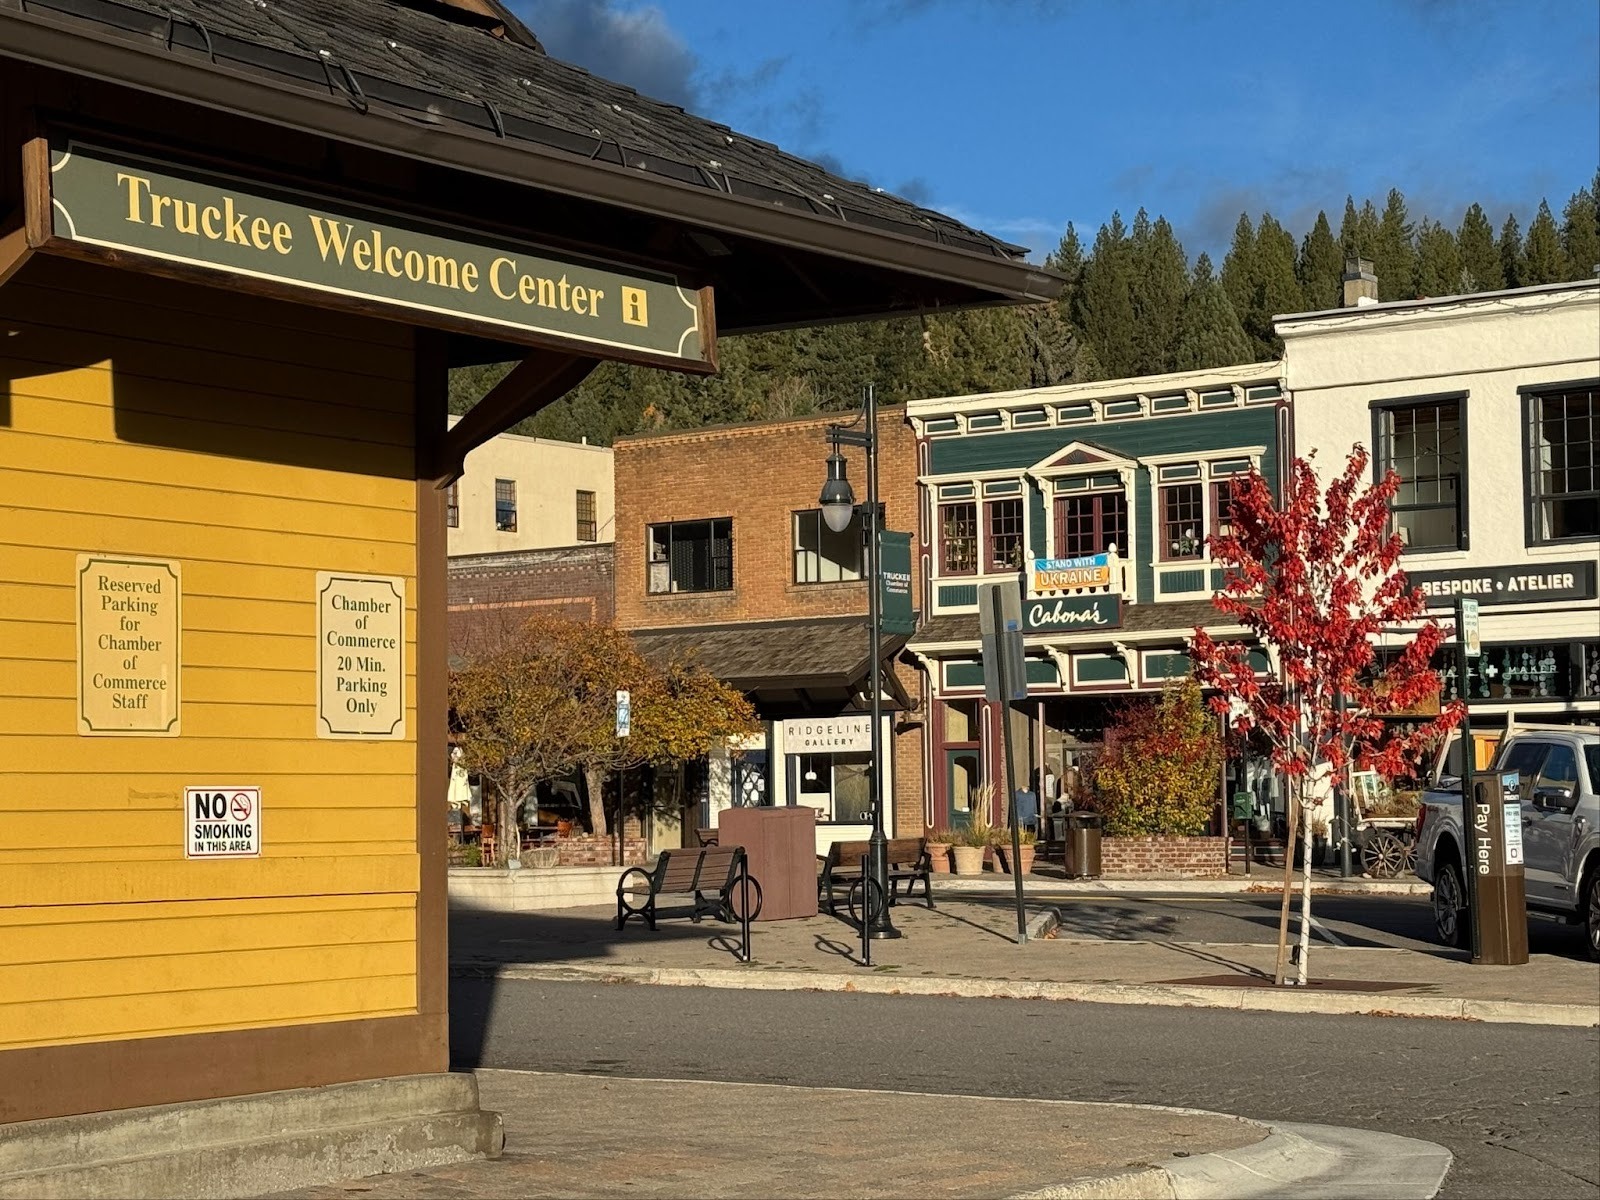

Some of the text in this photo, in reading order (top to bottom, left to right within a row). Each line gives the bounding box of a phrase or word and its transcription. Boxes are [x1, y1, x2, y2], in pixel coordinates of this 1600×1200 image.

[117, 172, 292, 256] Truckee
[308, 213, 479, 293] Welcome
[488, 257, 604, 318] Center
[1045, 557, 1096, 569] STAND WITH
[98, 575, 161, 594] Reserved
[1041, 568, 1102, 586] UKRAINE
[1422, 573, 1574, 597] BESPOKE ATELIER
[101, 595, 158, 616] Parking
[331, 594, 391, 614] Chamber
[355, 615, 369, 630] of
[1029, 600, 1108, 627] Cabona's
[120, 616, 141, 631] for
[98, 634, 162, 652] Chamber
[327, 631, 396, 650] Commerce
[123, 656, 138, 670] of
[337, 656, 386, 672] 20 Min.
[1508, 664, 1557, 674] MAKER
[93, 673, 167, 690] Commerce
[336, 676, 388, 697] Parking
[112, 693, 149, 709] Staff
[346, 697, 377, 717] Only
[788, 724, 871, 736] RIDGELINE
[805, 738, 853, 746] GALLERY
[195, 793, 227, 819] NO
[195, 824, 252, 839] SMOKING
[1474, 804, 1491, 875] Pay Here
[194, 840, 251, 852] IN THIS AREA
